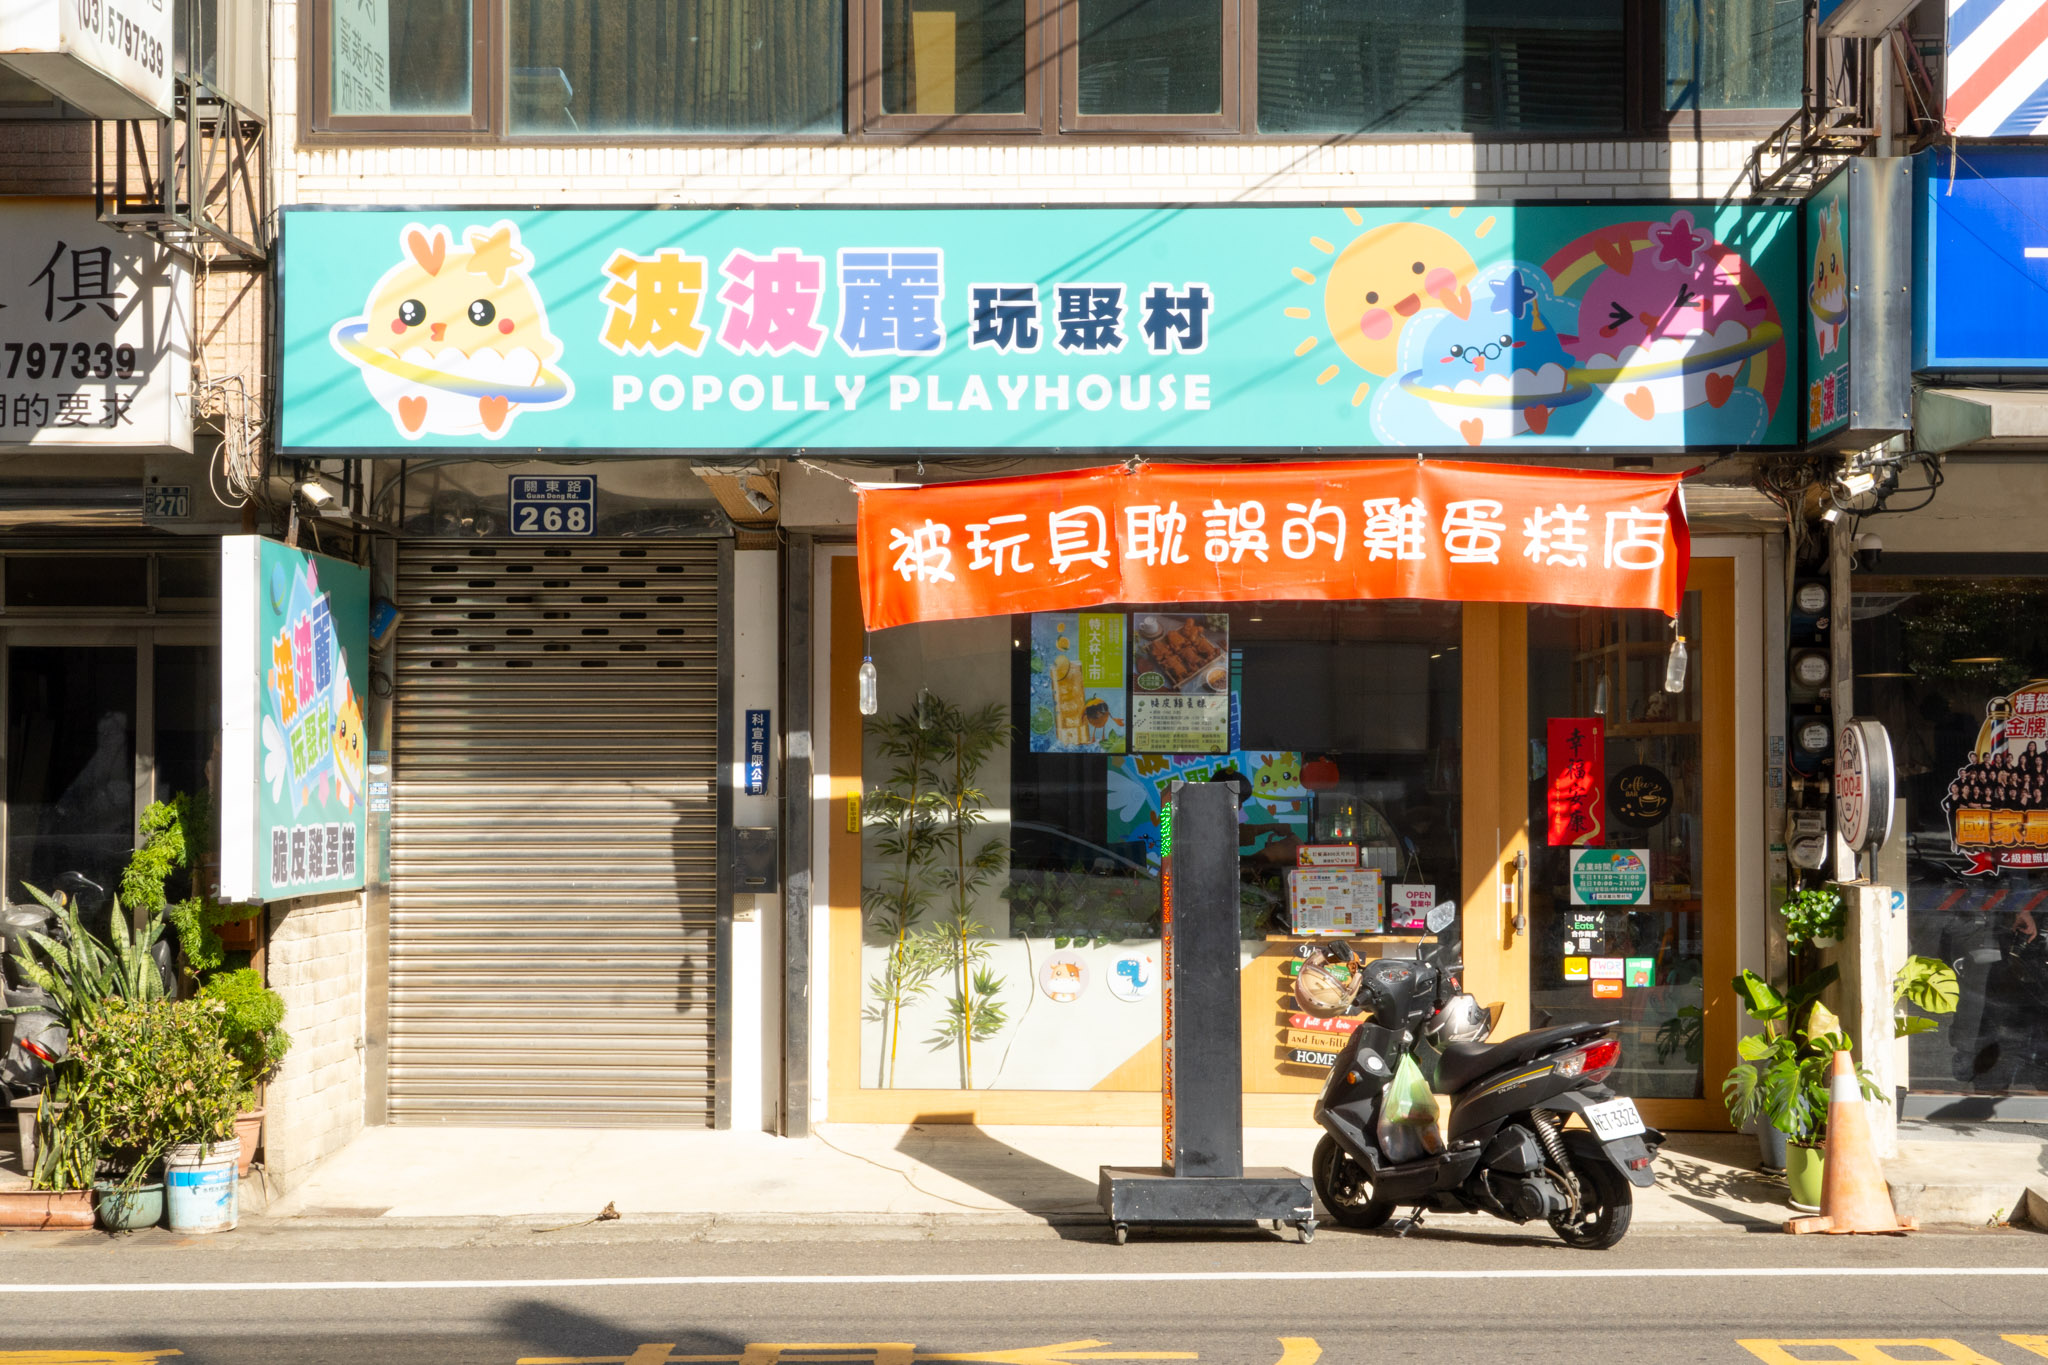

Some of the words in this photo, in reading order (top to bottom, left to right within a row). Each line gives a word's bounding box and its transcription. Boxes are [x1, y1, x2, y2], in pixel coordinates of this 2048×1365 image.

[108, 5, 164, 79] 5797339
[612, 374, 867, 412] POPOLLY
[890, 374, 1211, 412] PLAYHOUSE
[524, 480, 582, 493] 關東路
[155, 495, 187, 516] 270
[520, 506, 586, 531] 268
[889, 496, 1669, 584] 被玩具耽誤的雞蛋糕店
[272, 591, 332, 729] 波波麗
[1088, 617, 1102, 681] 特大杯上市
[290, 696, 330, 785] 玩聚村
[752, 713, 765, 794] 科宣有限公司
[1566, 728, 1588, 833] 幸福安康
[1620, 776, 1653, 792] Coffee
[271, 822, 357, 889] 脆皮雞蛋糕
[1577, 863, 1611, 871] 營業時間
[1406, 891, 1432, 899] OPEN
[1410, 900, 1432, 908] 營業中
[1574, 913, 1595, 922] Uber
[1574, 922, 1595, 930] Eats
[1304, 1017, 1321, 1029] full
[1323, 1018, 1333, 1030] of
[1336, 1019, 1352, 1029] love
[1296, 1050, 1337, 1066] HOME
